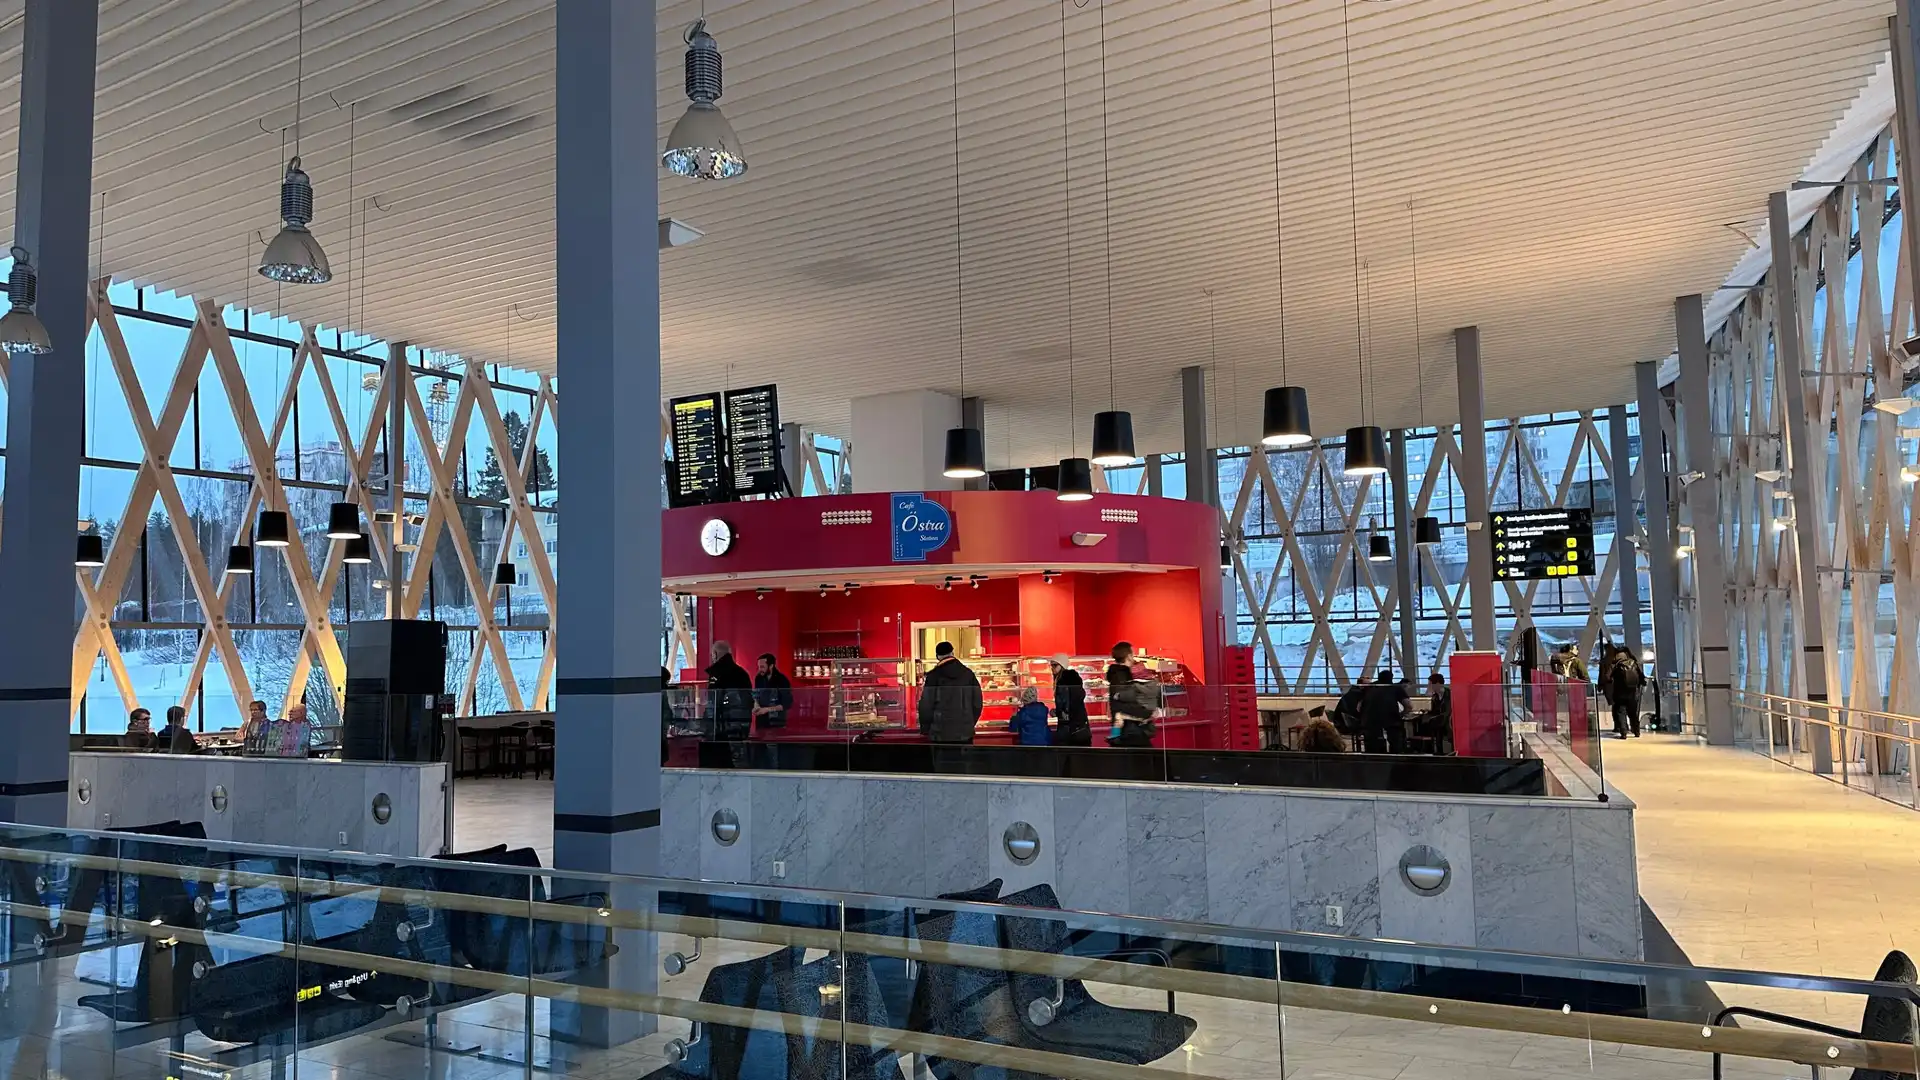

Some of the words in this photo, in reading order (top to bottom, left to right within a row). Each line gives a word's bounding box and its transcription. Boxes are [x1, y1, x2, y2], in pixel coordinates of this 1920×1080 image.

[902, 511, 944, 531] Östra
[1508, 540, 1525, 550] Spår
[1525, 540, 1531, 549] 2
[1508, 554, 1526, 562] Buss
